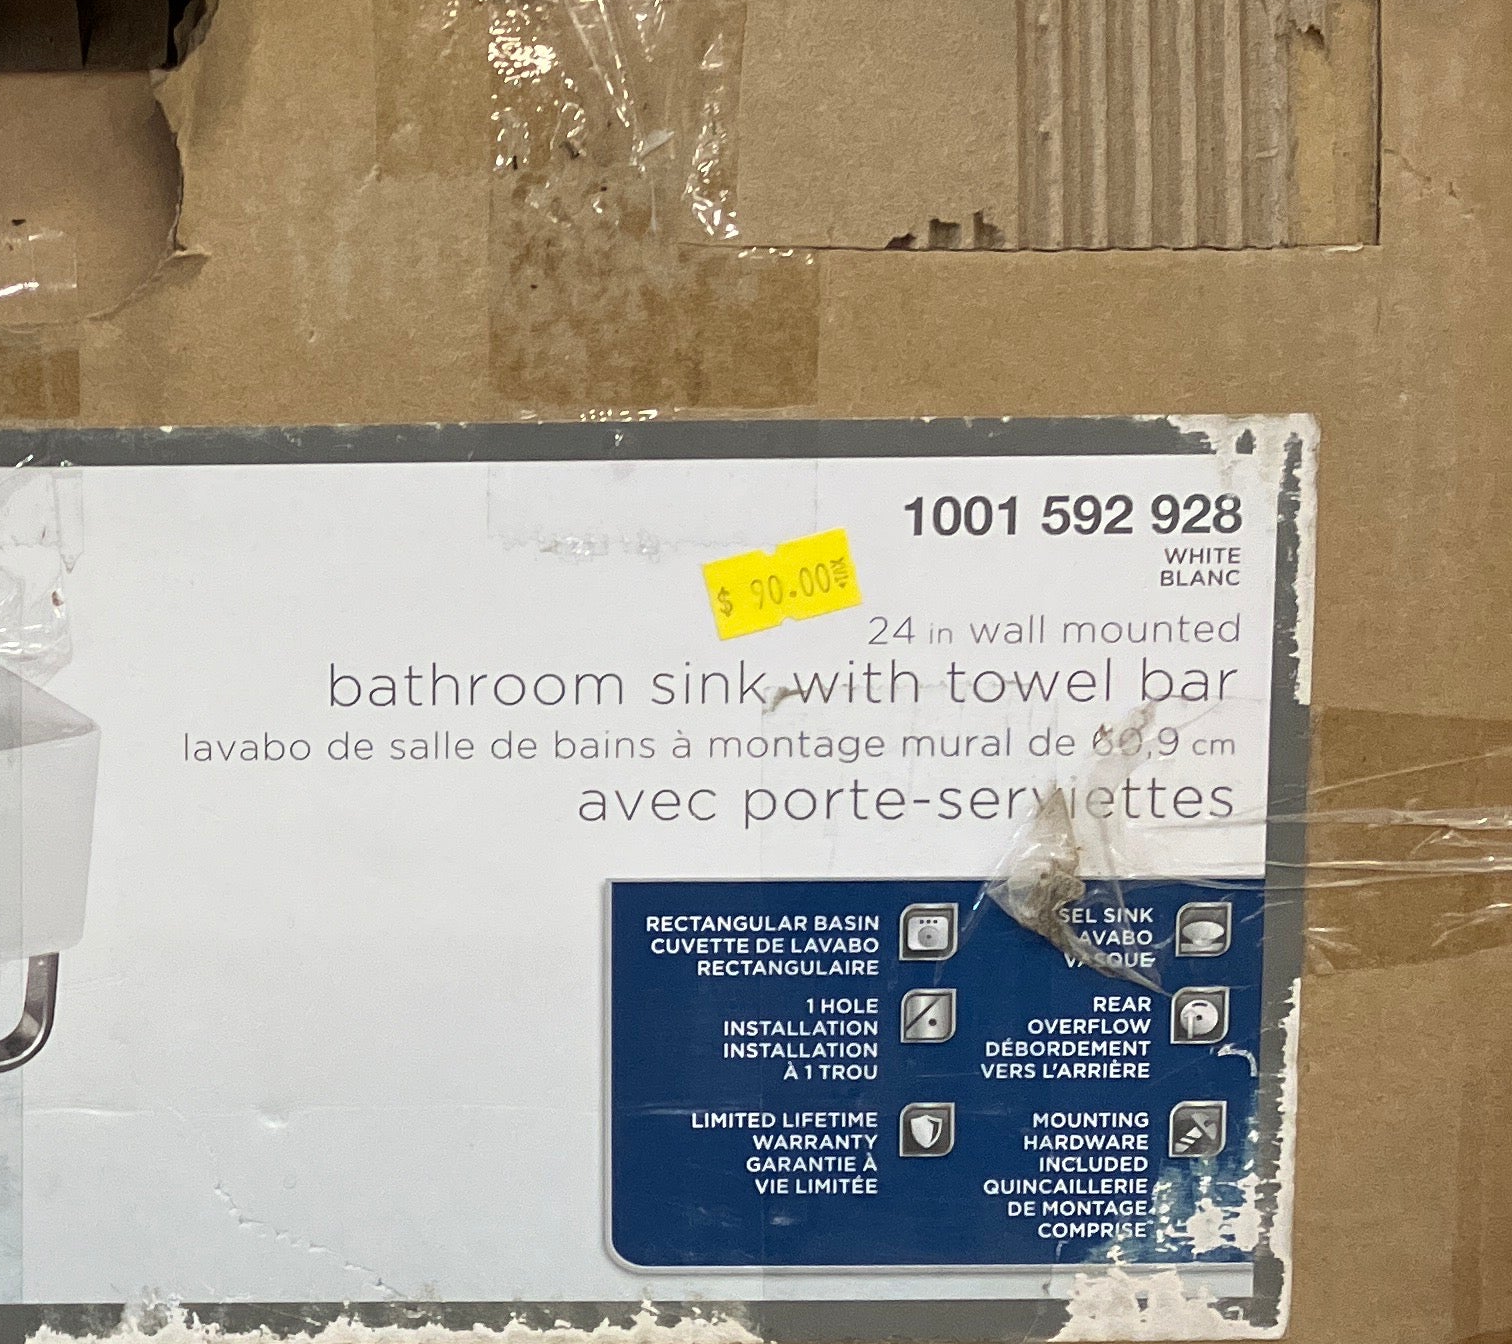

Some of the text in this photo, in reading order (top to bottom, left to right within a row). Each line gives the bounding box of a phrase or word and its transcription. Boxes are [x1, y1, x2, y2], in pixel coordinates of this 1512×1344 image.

[904, 494, 1243, 536] 1001 592 928
[1164, 547, 1241, 564] WHITE
[750, 563, 830, 610] 90.00
[1160, 569, 1241, 587] BLANC
[868, 613, 1240, 645] 24 in wall mounted
[329, 657, 1238, 707] bathroom sink with towel bar
[184, 732, 311, 762] lavabo
[327, 731, 373, 760] de
[390, 731, 474, 760] salle
[490, 731, 537, 759] de
[555, 730, 655, 759] bains
[671, 730, 691, 759] à
[709, 730, 885, 763] montage
[902, 728, 1011, 757] mural
[1029, 727, 1076, 757] de
[1192, 738, 1235, 756] cm
[579, 786, 717, 823] avec
[646, 915, 879, 932] RECTANGULAR BASIN
[1103, 907, 1154, 923] SINK
[650, 937, 880, 954] CUVETTE DE LAVABO
[1078, 929, 1153, 946] AVABO
[697, 959, 879, 976] RECTANGULAIRE
[806, 998, 879, 1014] 1 HOLE
[1093, 996, 1151, 1013] REAR
[723, 1020, 879, 1037] INSTALLATION
[1027, 1019, 1151, 1035] OVERFLOW
[723, 1042, 878, 1059] INSTALLATION
[985, 1037, 1151, 1057] DÉBORDEMENT
[783, 1060, 878, 1080] À 1 TROU
[980, 1058, 1150, 1080] VERS L'ARRIÈRE
[691, 1112, 878, 1129] LIMITED LIFETIME
[1033, 1112, 1149, 1129] MOUNTING
[752, 1134, 878, 1150] WARRANTY
[1023, 1134, 1149, 1151] HARDWARE
[746, 1152, 878, 1173] GARANTIE À
[1039, 1156, 1149, 1173] INCLUDED
[754, 1174, 878, 1194] VIE LIMITÉE
[983, 1178, 1148, 1195] QUINCAILLERIE
[1007, 1200, 1148, 1217] DE MONTAGE
[1038, 1222, 1147, 1239] COMPRISE
